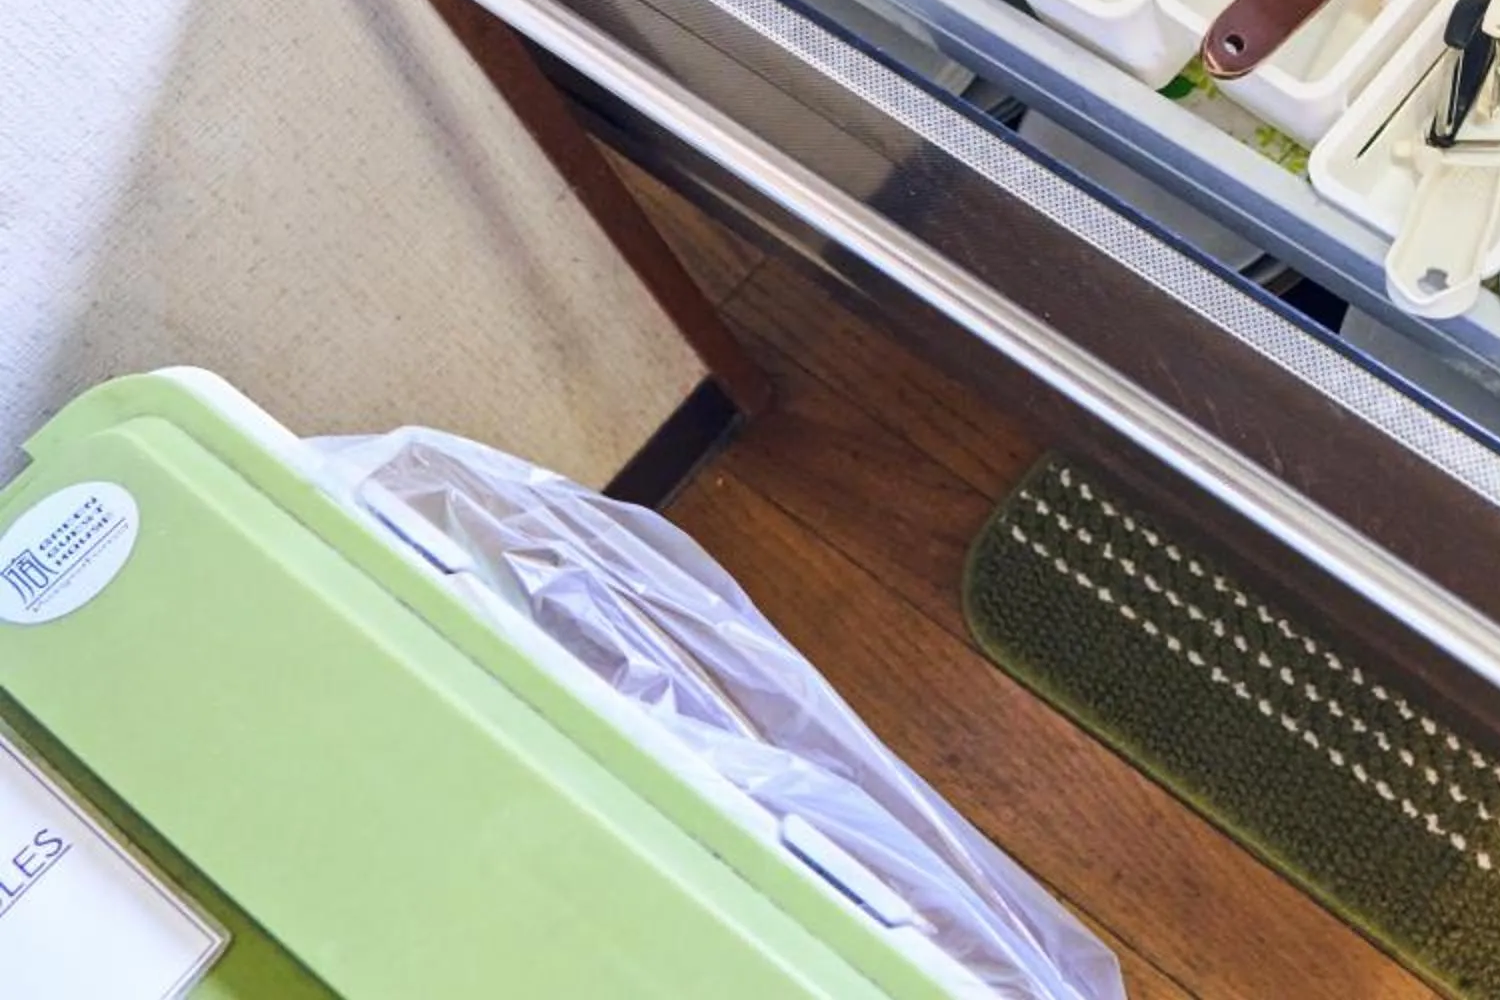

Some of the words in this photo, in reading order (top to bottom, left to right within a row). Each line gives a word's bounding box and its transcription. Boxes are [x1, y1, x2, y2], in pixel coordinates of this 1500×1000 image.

[47, 503, 103, 558] GUEST
[55, 512, 113, 566] HOUSE
[0, 828, 63, 907] LES
